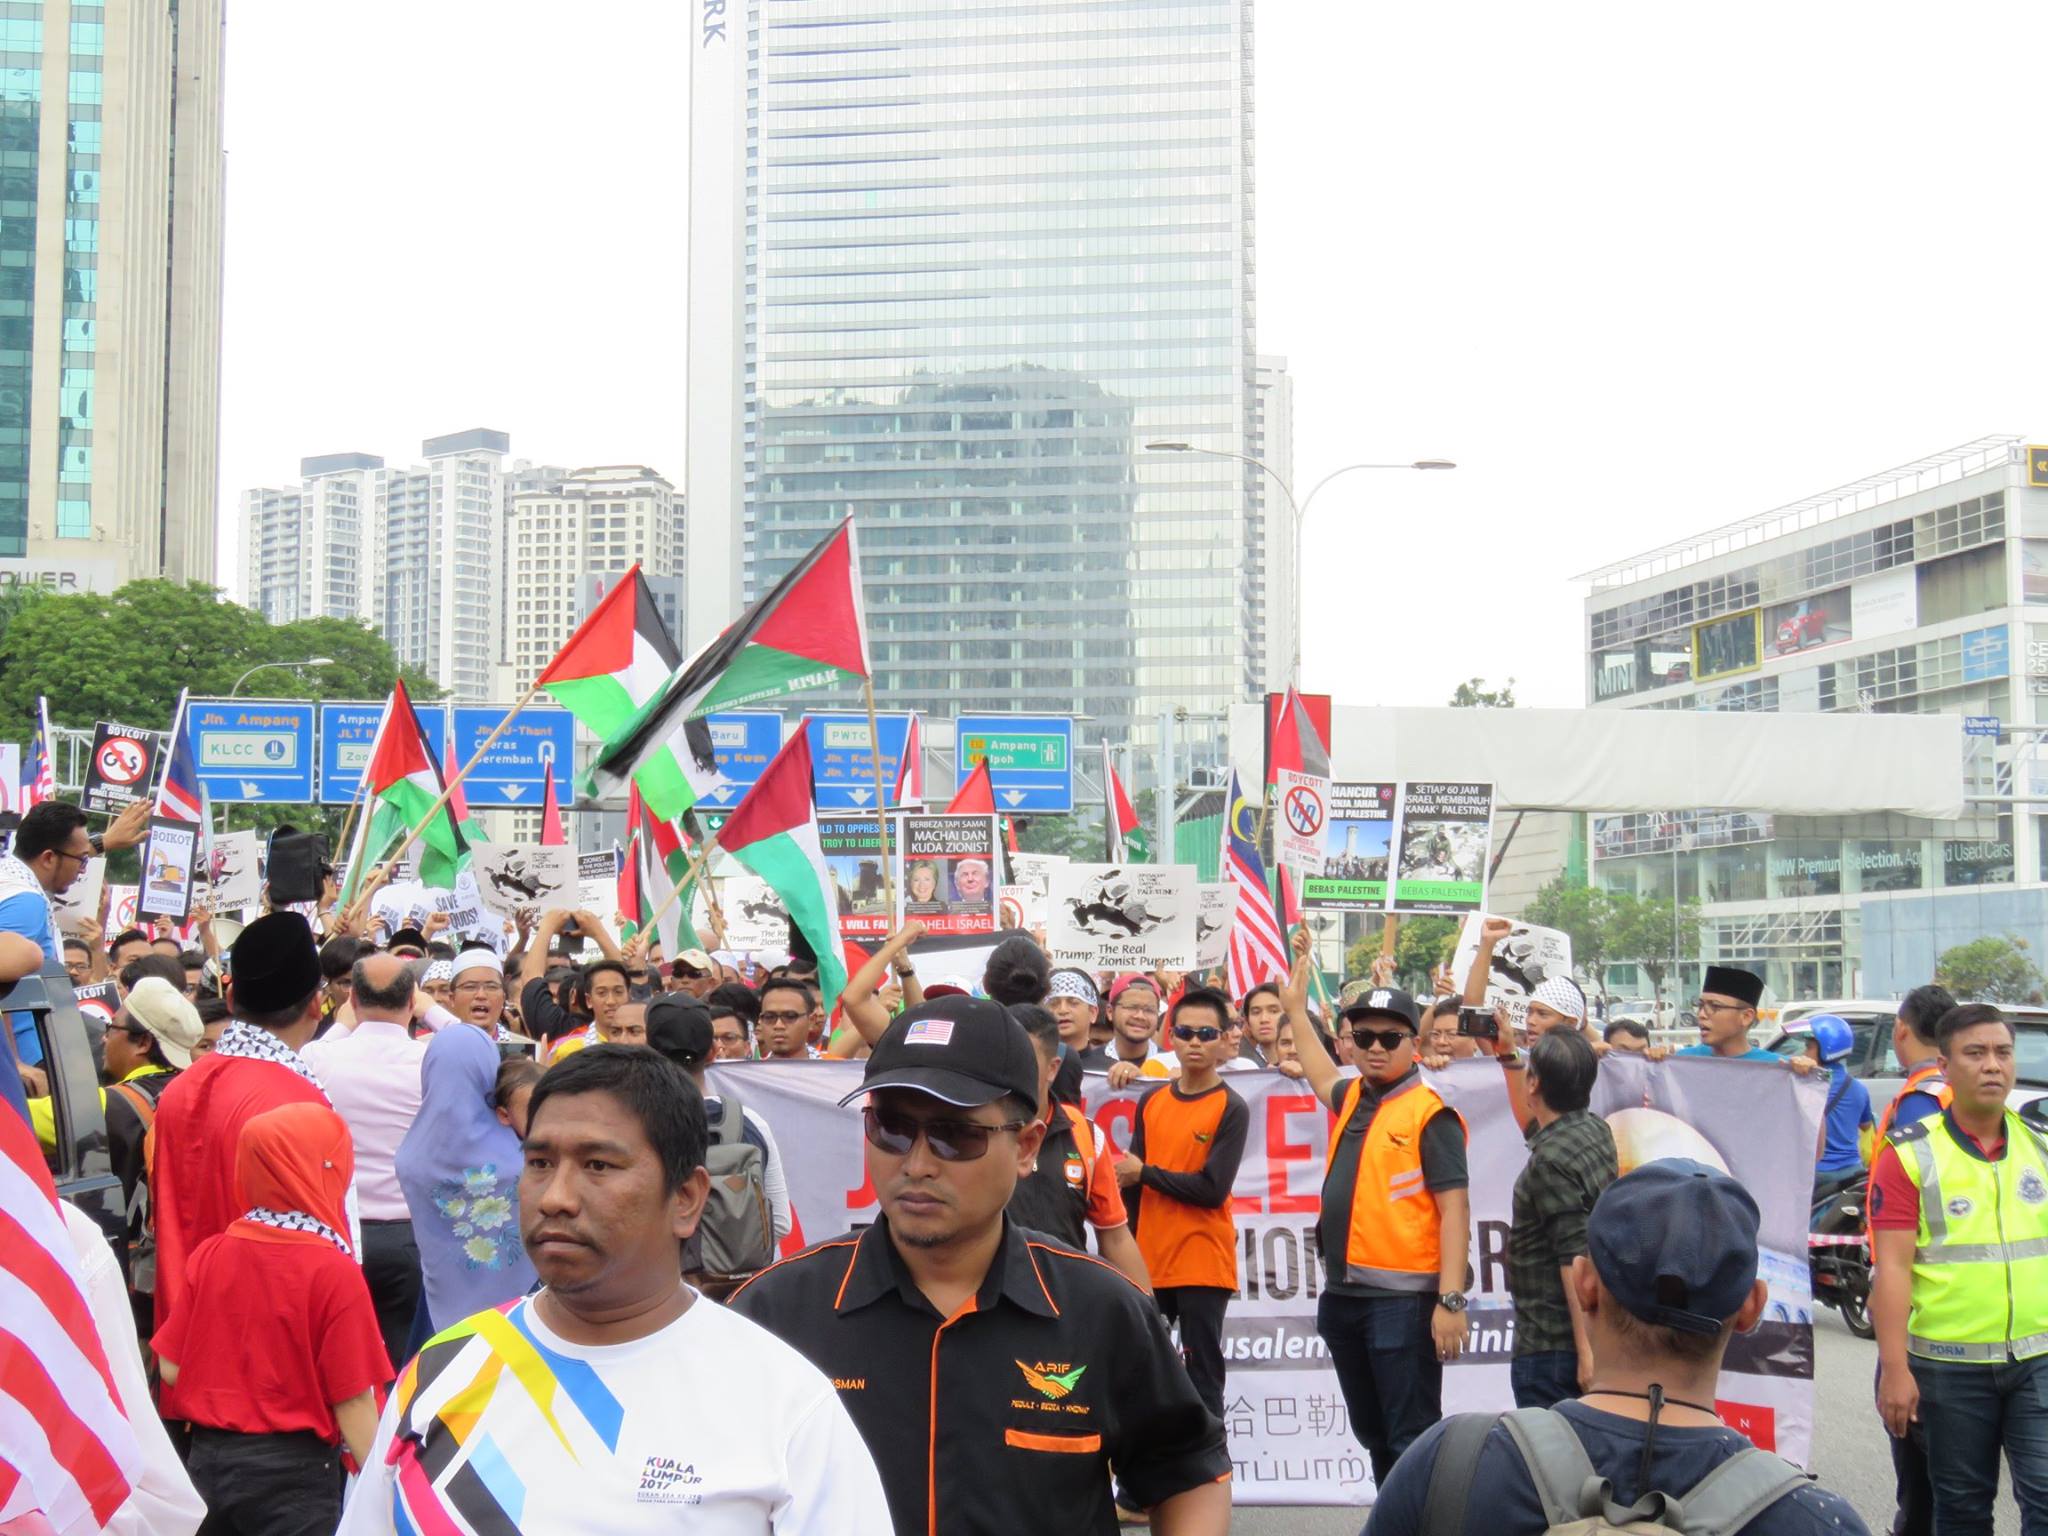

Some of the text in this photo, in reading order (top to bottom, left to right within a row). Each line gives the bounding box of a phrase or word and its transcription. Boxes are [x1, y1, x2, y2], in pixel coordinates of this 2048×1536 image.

[238, 713, 299, 729] Ampang
[338, 714, 379, 725] Ampan
[107, 725, 151, 741] BOYCOTT
[711, 731, 739, 740] Baru
[832, 731, 867, 740] PWTC
[211, 744, 253, 755] KLCC
[474, 739, 517, 750] Ceras
[991, 741, 1037, 752] Ampang
[477, 754, 533, 764] eremban
[990, 754, 1014, 765] Ipoh
[1331, 786, 1377, 798] HANCUR
[1416, 786, 1446, 794] SETIAP
[1436, 796, 1490, 805] MEMBUNUH
[1441, 806, 1488, 815] PALESTINE
[835, 825, 845, 833] TO
[847, 824, 895, 833] OPPRESES
[910, 821, 942, 829] BERBEZA
[152, 830, 191, 845] BOIKOT
[962, 831, 986, 840] DAN
[845, 839, 856, 848] TO
[858, 838, 896, 848] LIBERTE
[912, 842, 989, 853] KUDA ZIONIST
[1955, 842, 1982, 861] Used
[1000, 887, 1024, 895] YCOTT
[1308, 885, 1380, 895] BEBAS PALESTINE
[1401, 887, 1478, 898] BEBAS PALESTINE
[436, 895, 459, 912] SAVE
[846, 920, 870, 930] WILL
[927, 920, 954, 930] HELL
[957, 918, 993, 929] ISRAEL
[1098, 943, 1146, 954] The Real
[1053, 949, 1096, 963] Trump:
[1098, 955, 1136, 967] Zionist
[74, 986, 106, 1000] YCOTT
[1034, 1361, 1071, 1373] ARIF
[646, 1456, 694, 1474] KUALA
[642, 1466, 702, 1484] LUMPUR
[640, 1477, 671, 1490] 2017
